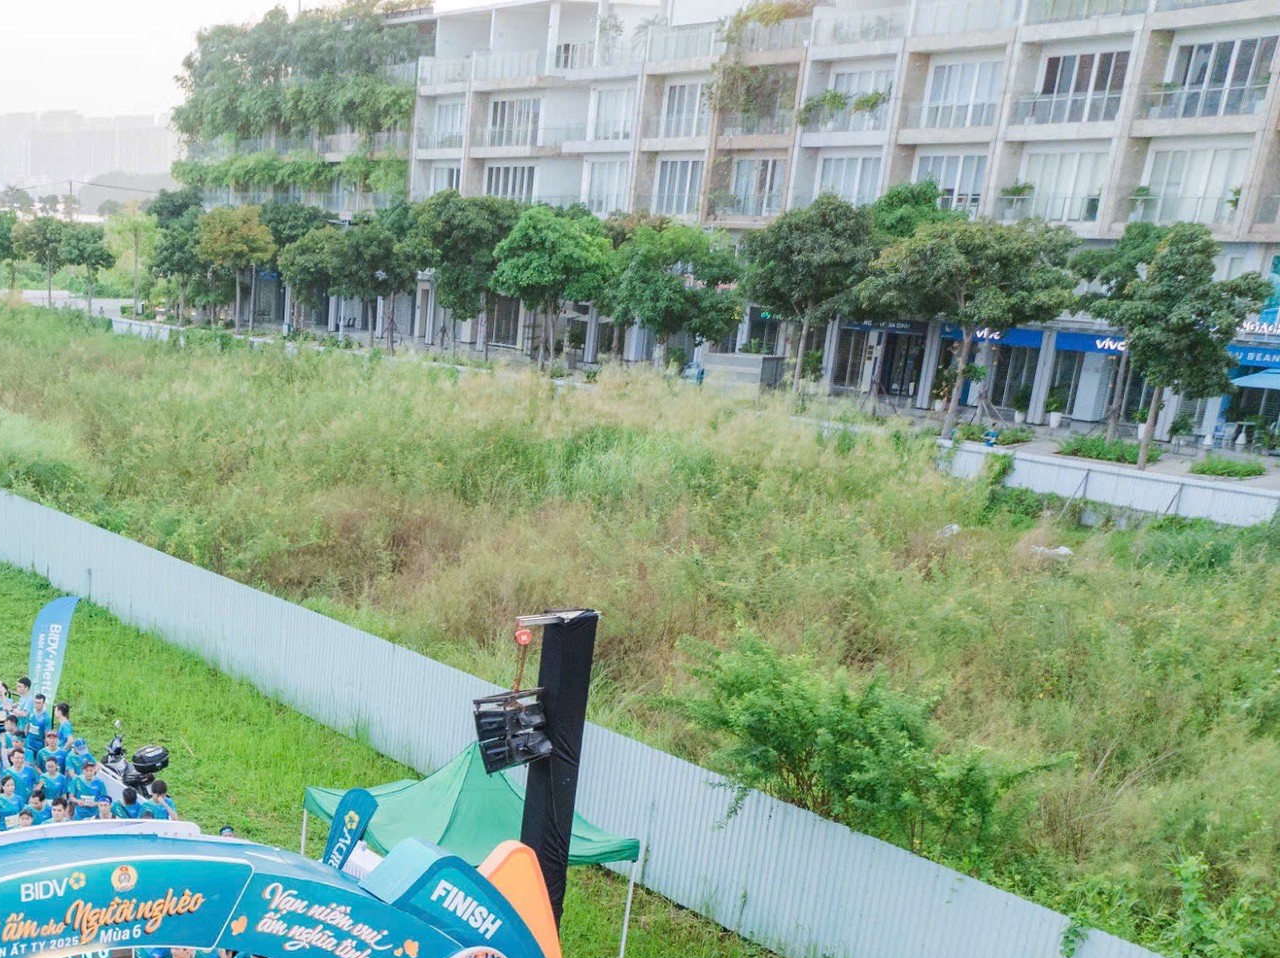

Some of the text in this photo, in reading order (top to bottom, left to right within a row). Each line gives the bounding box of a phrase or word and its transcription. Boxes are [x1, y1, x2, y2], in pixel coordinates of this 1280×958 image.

[21, 878, 68, 902] BIDV
[430, 879, 502, 940] FINISH
[2, 912, 40, 942] ấm
[41, 918, 66, 936] cho
[64, 896, 136, 945] Người
[135, 888, 205, 934] nghèo
[99, 925, 142, 943] Mùa 6
[256, 911, 289, 936] ấm
[284, 924, 338, 951] nghĩa
[263, 882, 394, 951] Vạn niềm vui
[49, 936, 79, 949] 2025
